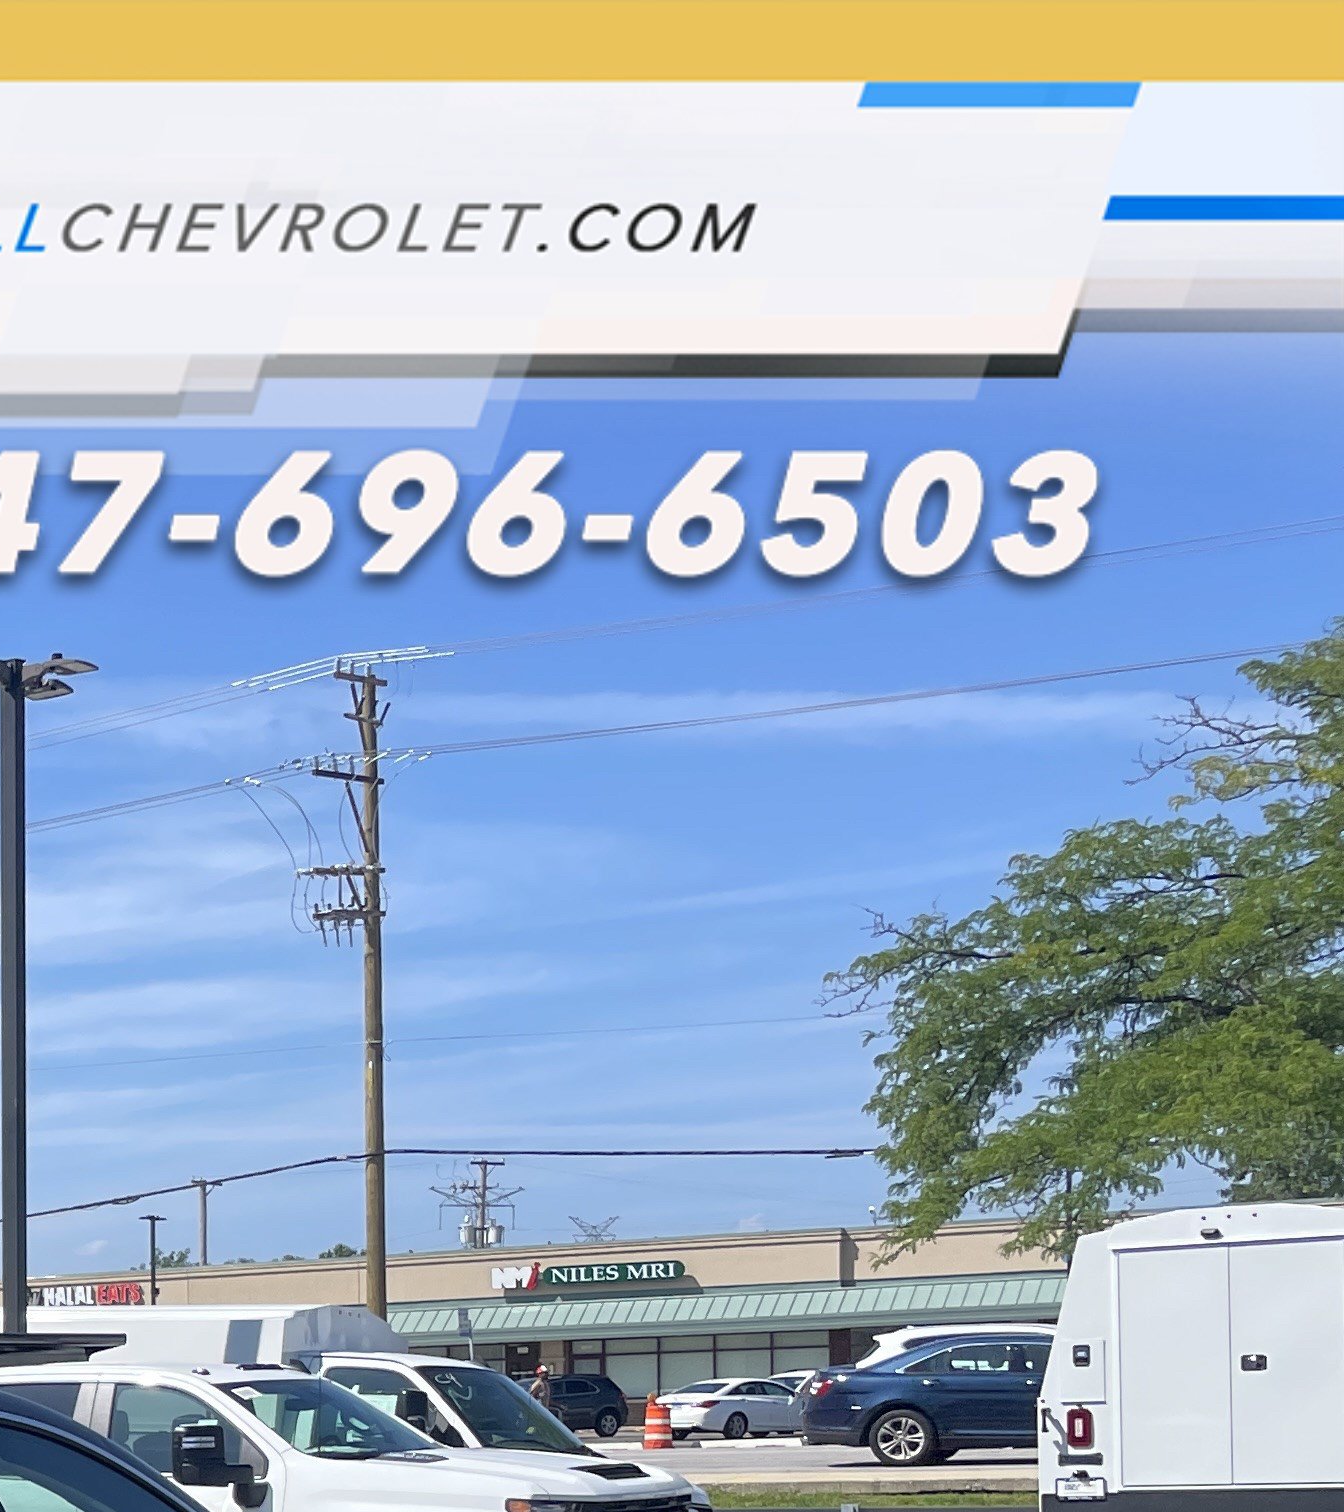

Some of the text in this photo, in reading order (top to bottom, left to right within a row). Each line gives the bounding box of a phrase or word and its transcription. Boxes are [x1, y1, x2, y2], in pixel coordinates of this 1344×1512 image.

[551, 1264, 619, 1283] NILES
[626, 1262, 676, 1280] MRI
[41, 1285, 94, 1306] HALAL
[97, 1282, 141, 1304] EATS
